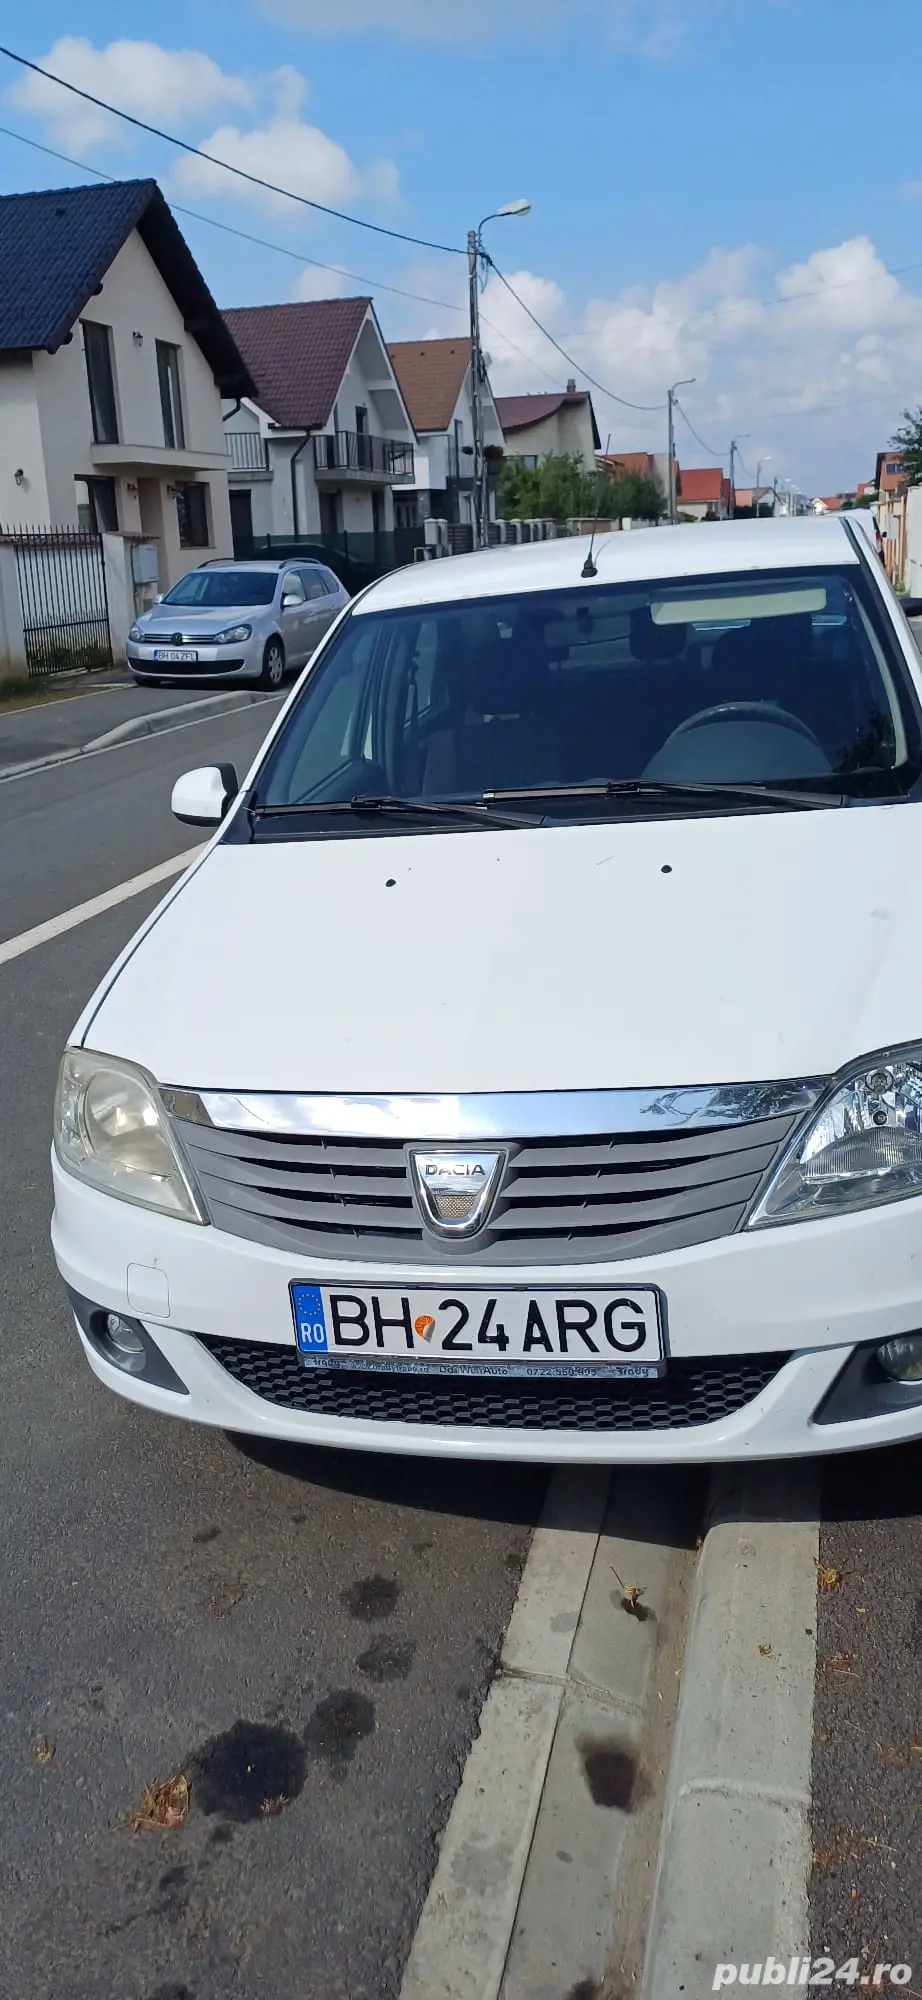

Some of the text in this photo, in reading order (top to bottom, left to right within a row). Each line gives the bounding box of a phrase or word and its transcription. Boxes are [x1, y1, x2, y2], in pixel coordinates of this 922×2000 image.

[425, 1164, 486, 1176] DACIA
[300, 1322, 325, 1345] RO
[329, 1294, 647, 1354] BH 24 ARG
